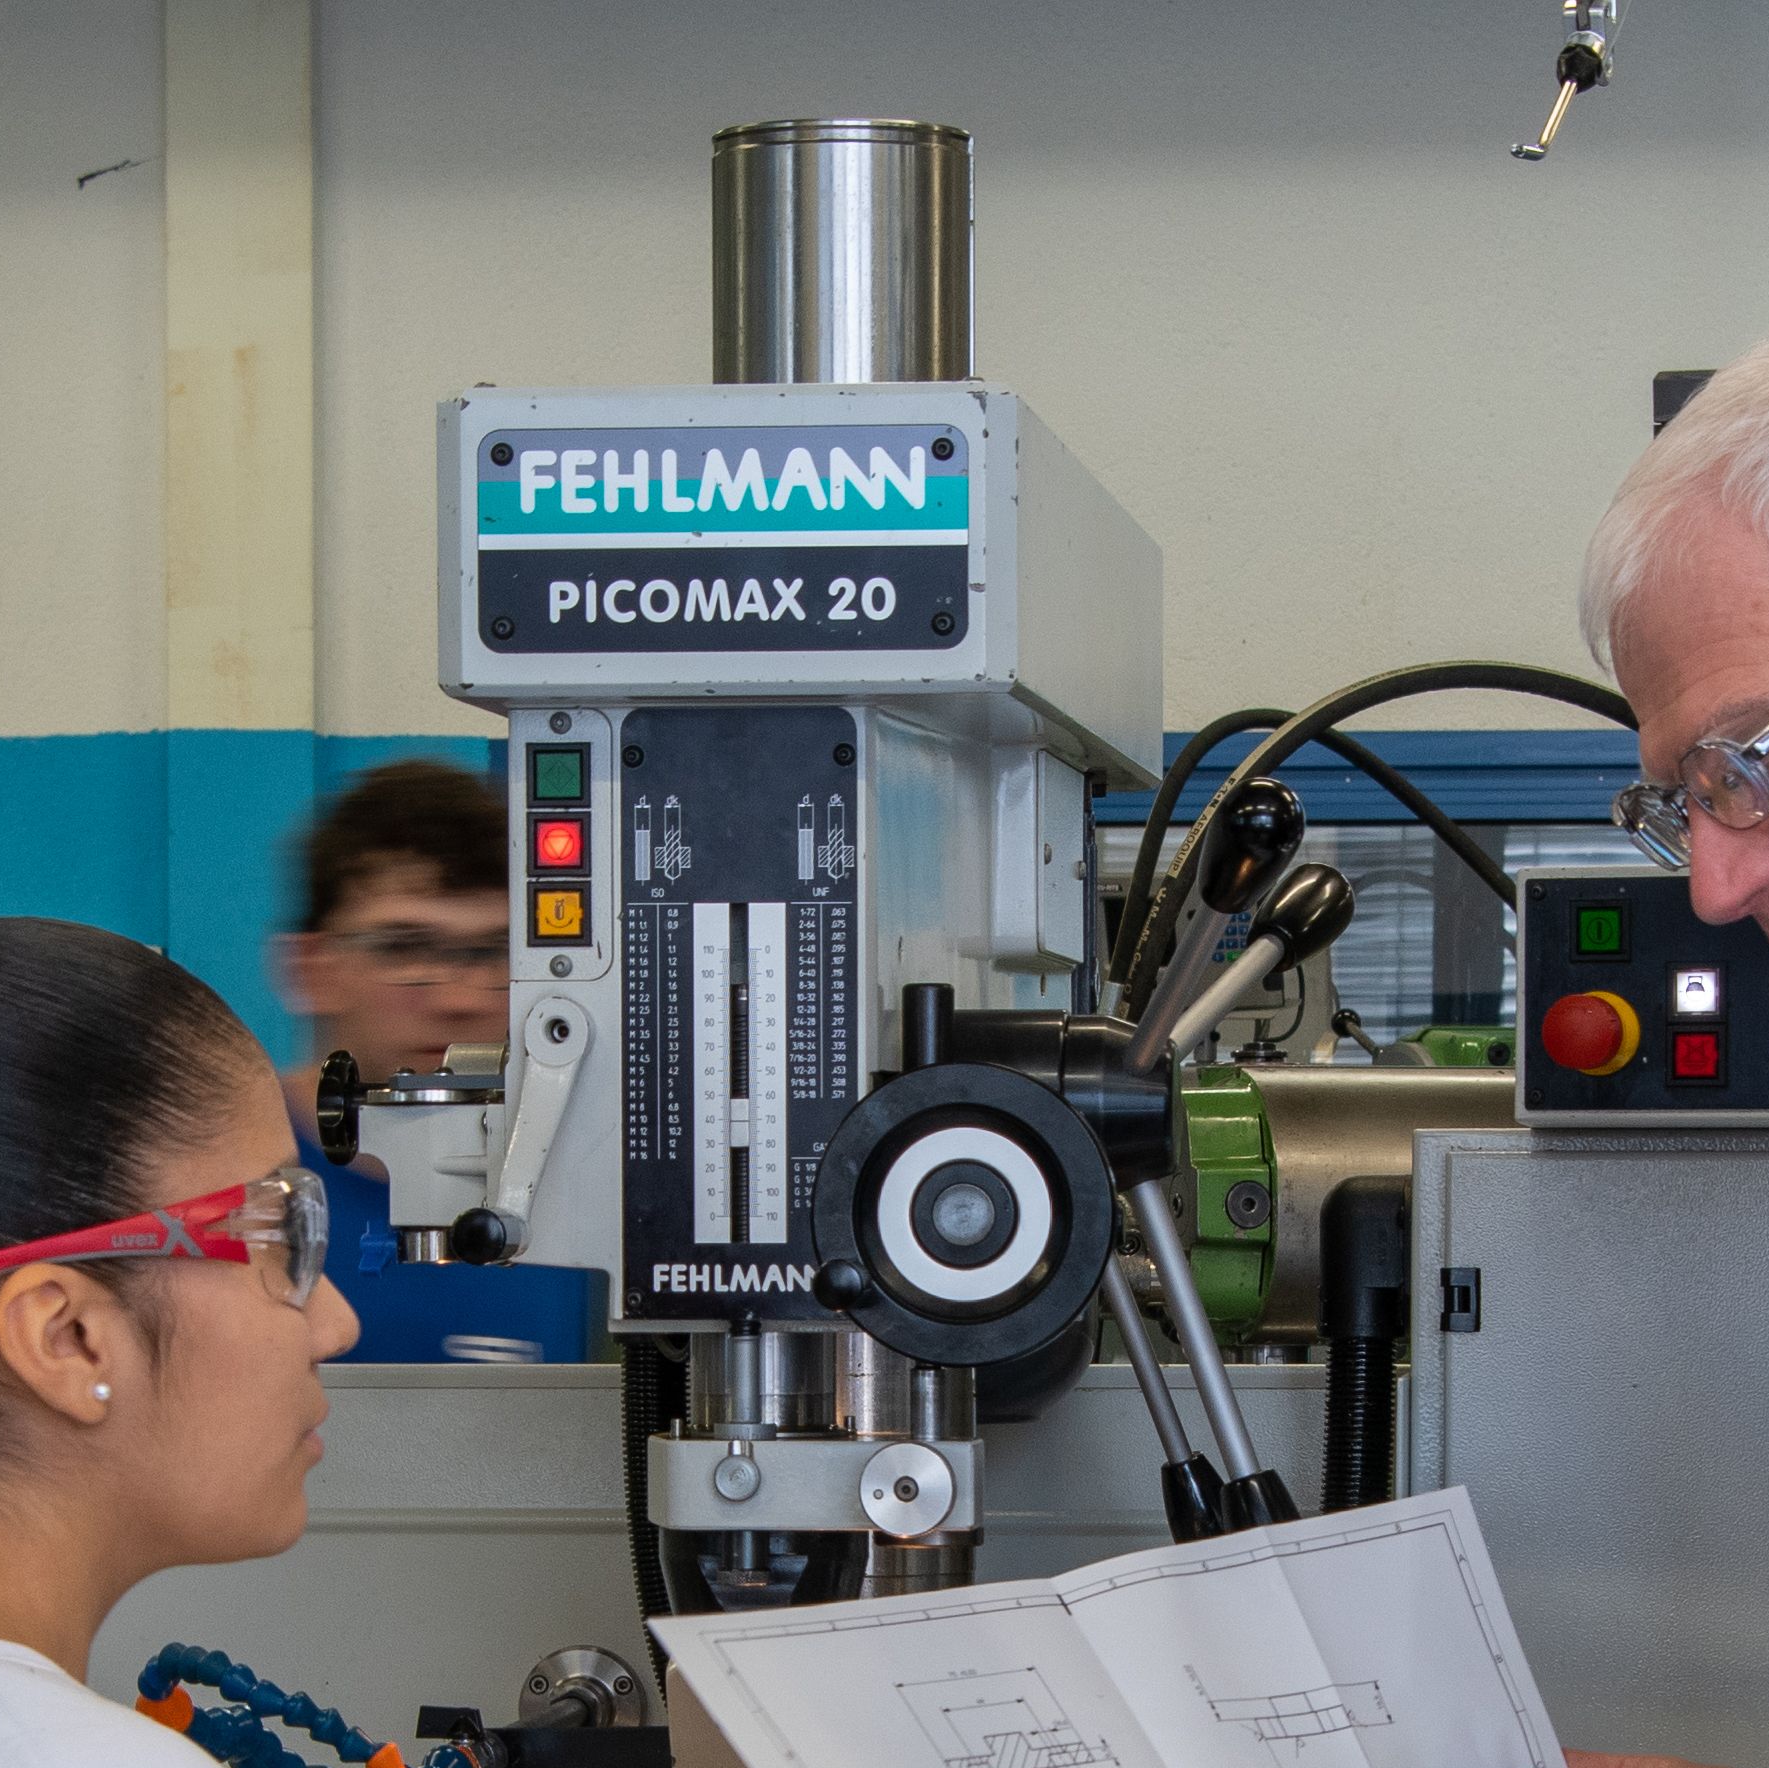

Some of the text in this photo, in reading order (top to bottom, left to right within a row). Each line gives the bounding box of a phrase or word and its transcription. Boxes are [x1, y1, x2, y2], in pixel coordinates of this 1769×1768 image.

[519, 445, 927, 514] FEHLMANN
[548, 577, 897, 623] PICOMAX 20
[639, 794, 647, 805] d
[802, 793, 810, 804] d
[650, 887, 665, 898] ISO
[812, 886, 830, 897] UNF
[702, 944, 715, 955] 110
[764, 944, 771, 955] 0
[700, 969, 715, 979] 100
[765, 968, 775, 979] 10
[703, 993, 715, 1004] 90
[765, 992, 777, 1004] 20
[703, 1017, 715, 1028] 80
[765, 1017, 776, 1028] 30
[704, 1041, 715, 1052] 70
[765, 1041, 777, 1052] 40
[703, 1066, 716, 1077] 60
[764, 1065, 777, 1077] 50
[704, 1090, 716, 1101] 50
[764, 1089, 776, 1101] 60
[704, 1114, 716, 1125] 40
[765, 1114, 777, 1125] 70
[705, 1138, 716, 1149] 30
[765, 1138, 777, 1149] 80
[812, 1141, 828, 1153] GA
[705, 1162, 716, 1174] 20
[765, 1162, 777, 1173] 90
[793, 1162, 801, 1172] G
[793, 1174, 801, 1184] G
[706, 1187, 716, 1197] 10
[766, 1187, 780, 1197] 100
[793, 1186, 801, 1197] G
[793, 1198, 801, 1209] G
[709, 1211, 717, 1222] 0
[766, 1211, 778, 1222] 110
